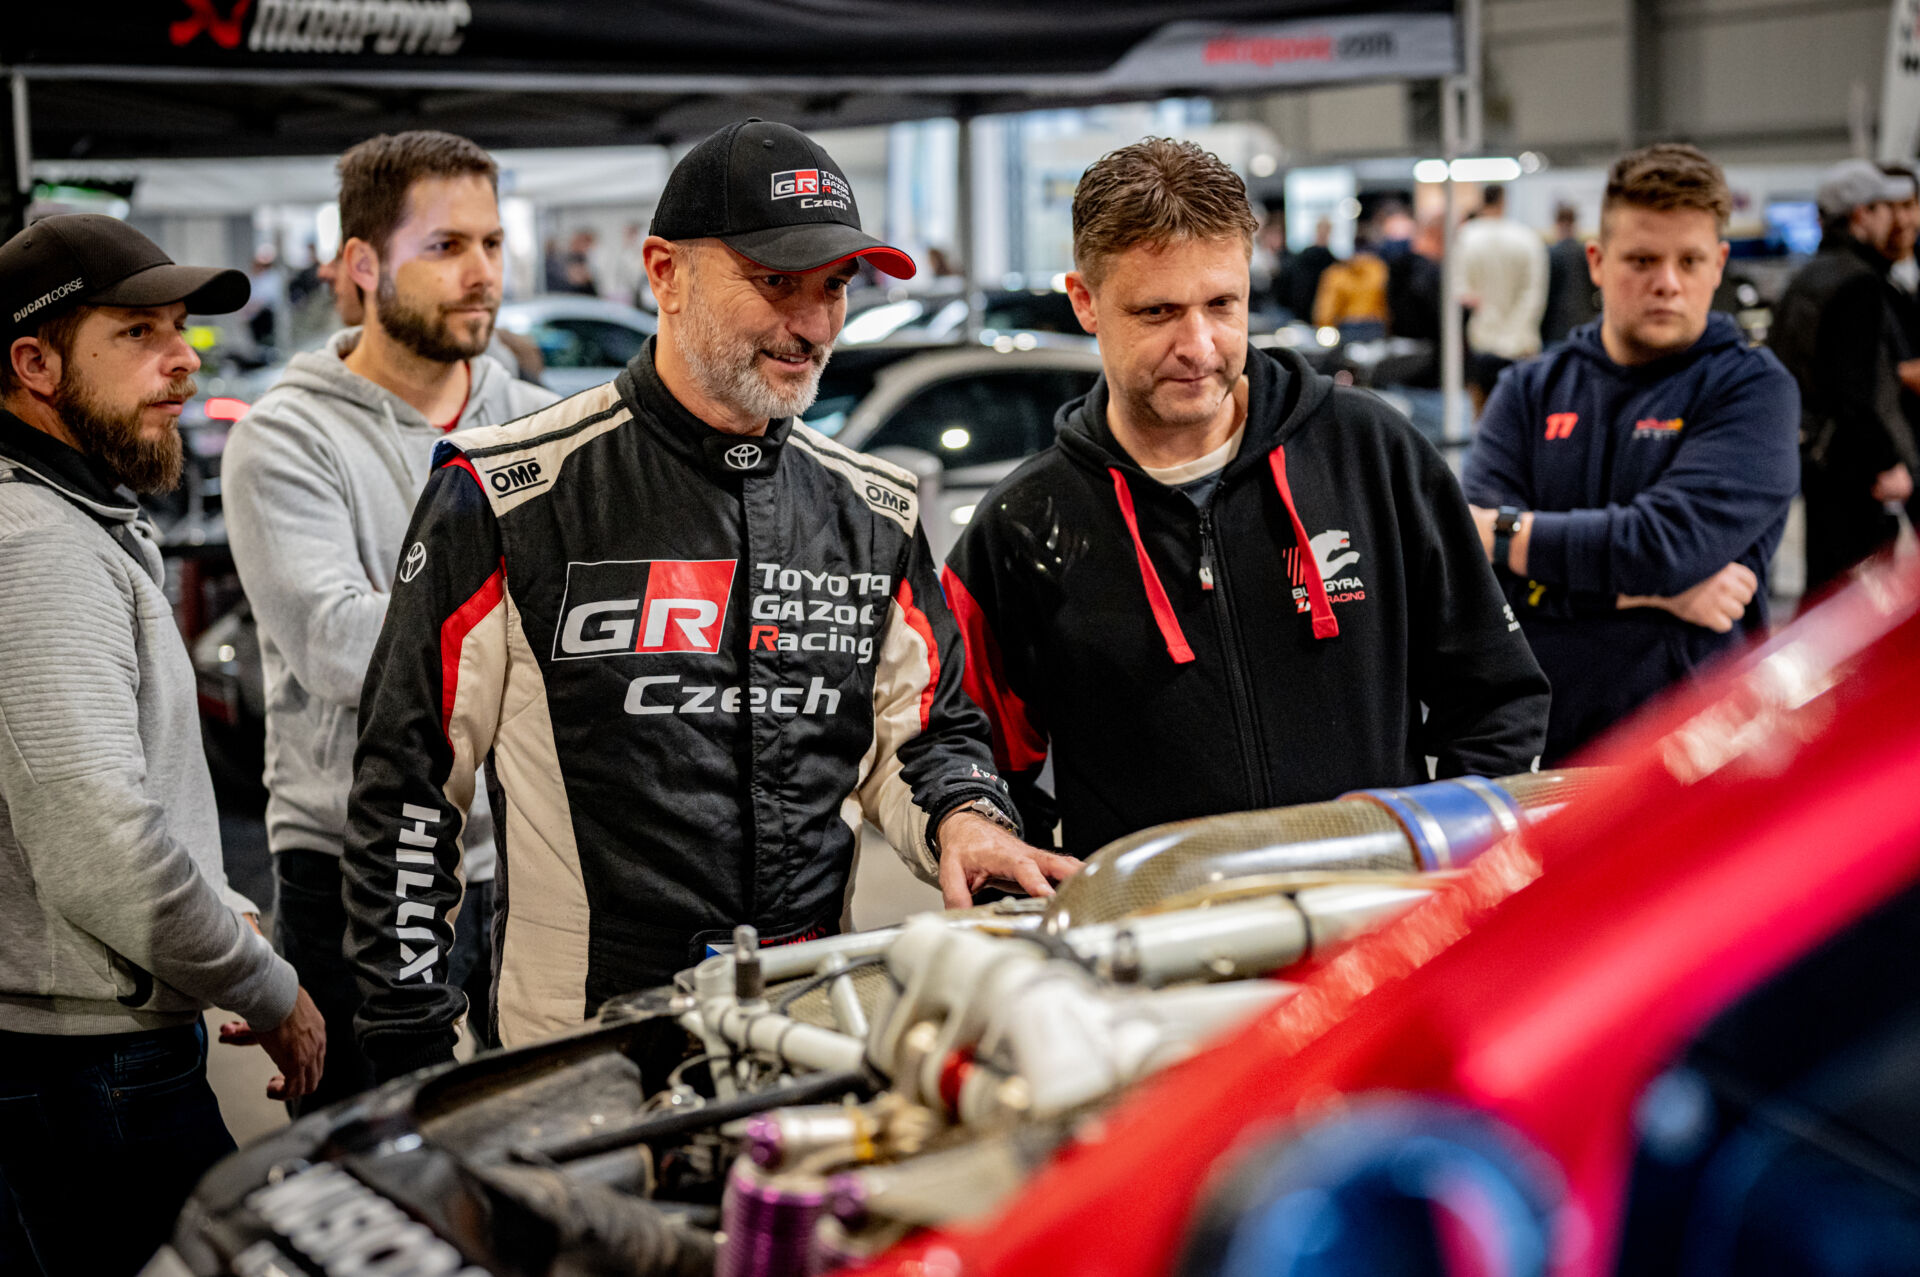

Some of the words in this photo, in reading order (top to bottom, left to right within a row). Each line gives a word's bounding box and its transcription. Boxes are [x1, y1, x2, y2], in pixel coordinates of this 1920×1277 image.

[774, 178, 817, 195] GR
[801, 198, 847, 210] Czech
[491, 462, 542, 492] OMP
[866, 485, 910, 513] OMP
[756, 563, 891, 596] TOYOTA
[561, 598, 719, 653] GR
[749, 625, 874, 664] Racing
[624, 674, 841, 715] Czech
[396, 802, 441, 984] HILUX
